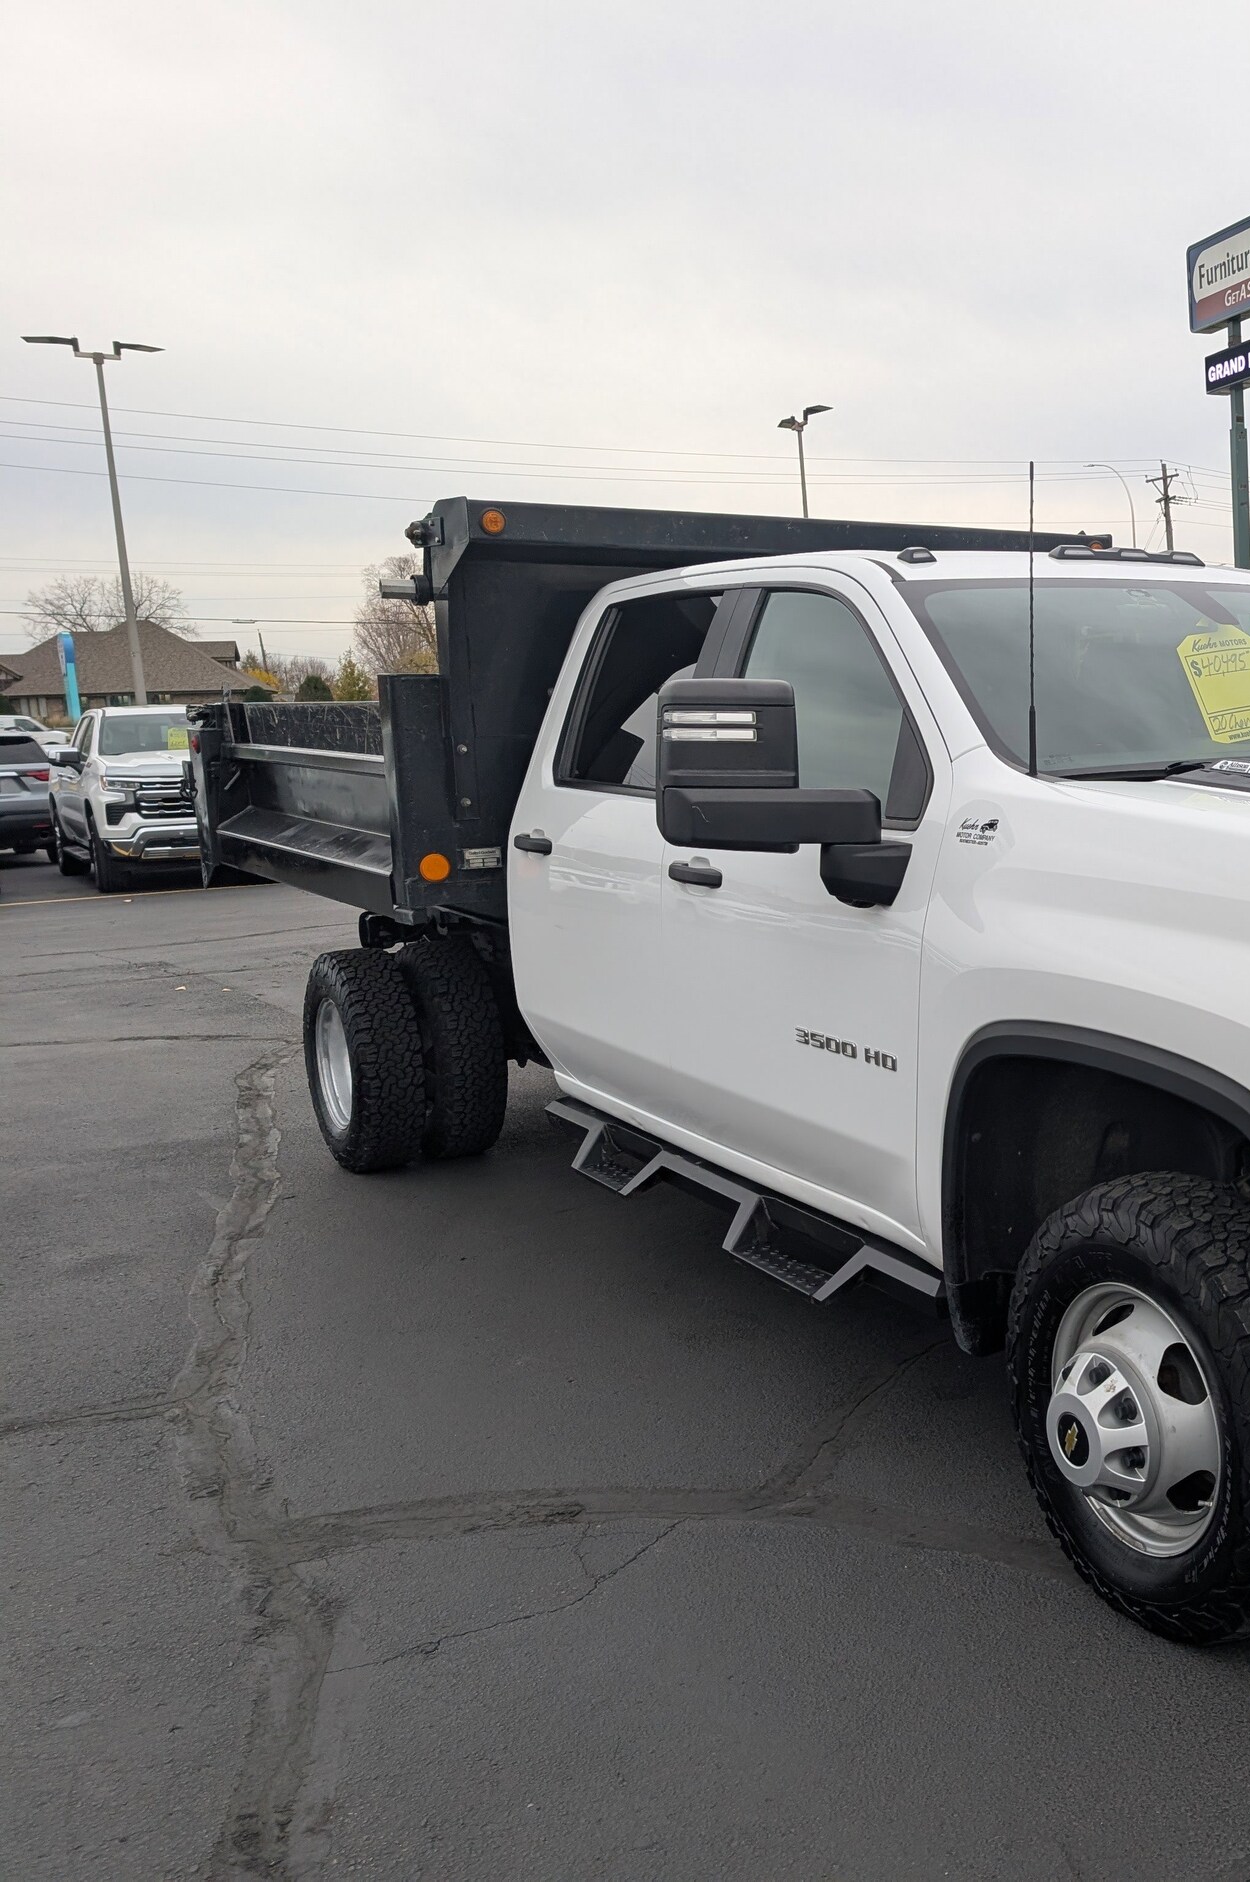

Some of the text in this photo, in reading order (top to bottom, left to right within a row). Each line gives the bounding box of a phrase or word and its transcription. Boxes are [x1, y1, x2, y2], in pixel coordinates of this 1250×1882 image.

[1208, 358, 1246, 382] GRAND
[1219, 639, 1247, 647] MOTORS
[955, 831, 972, 839] MOTOR
[972, 833, 996, 842] COMPANY
[794, 1026, 898, 1073] 3500 HD
